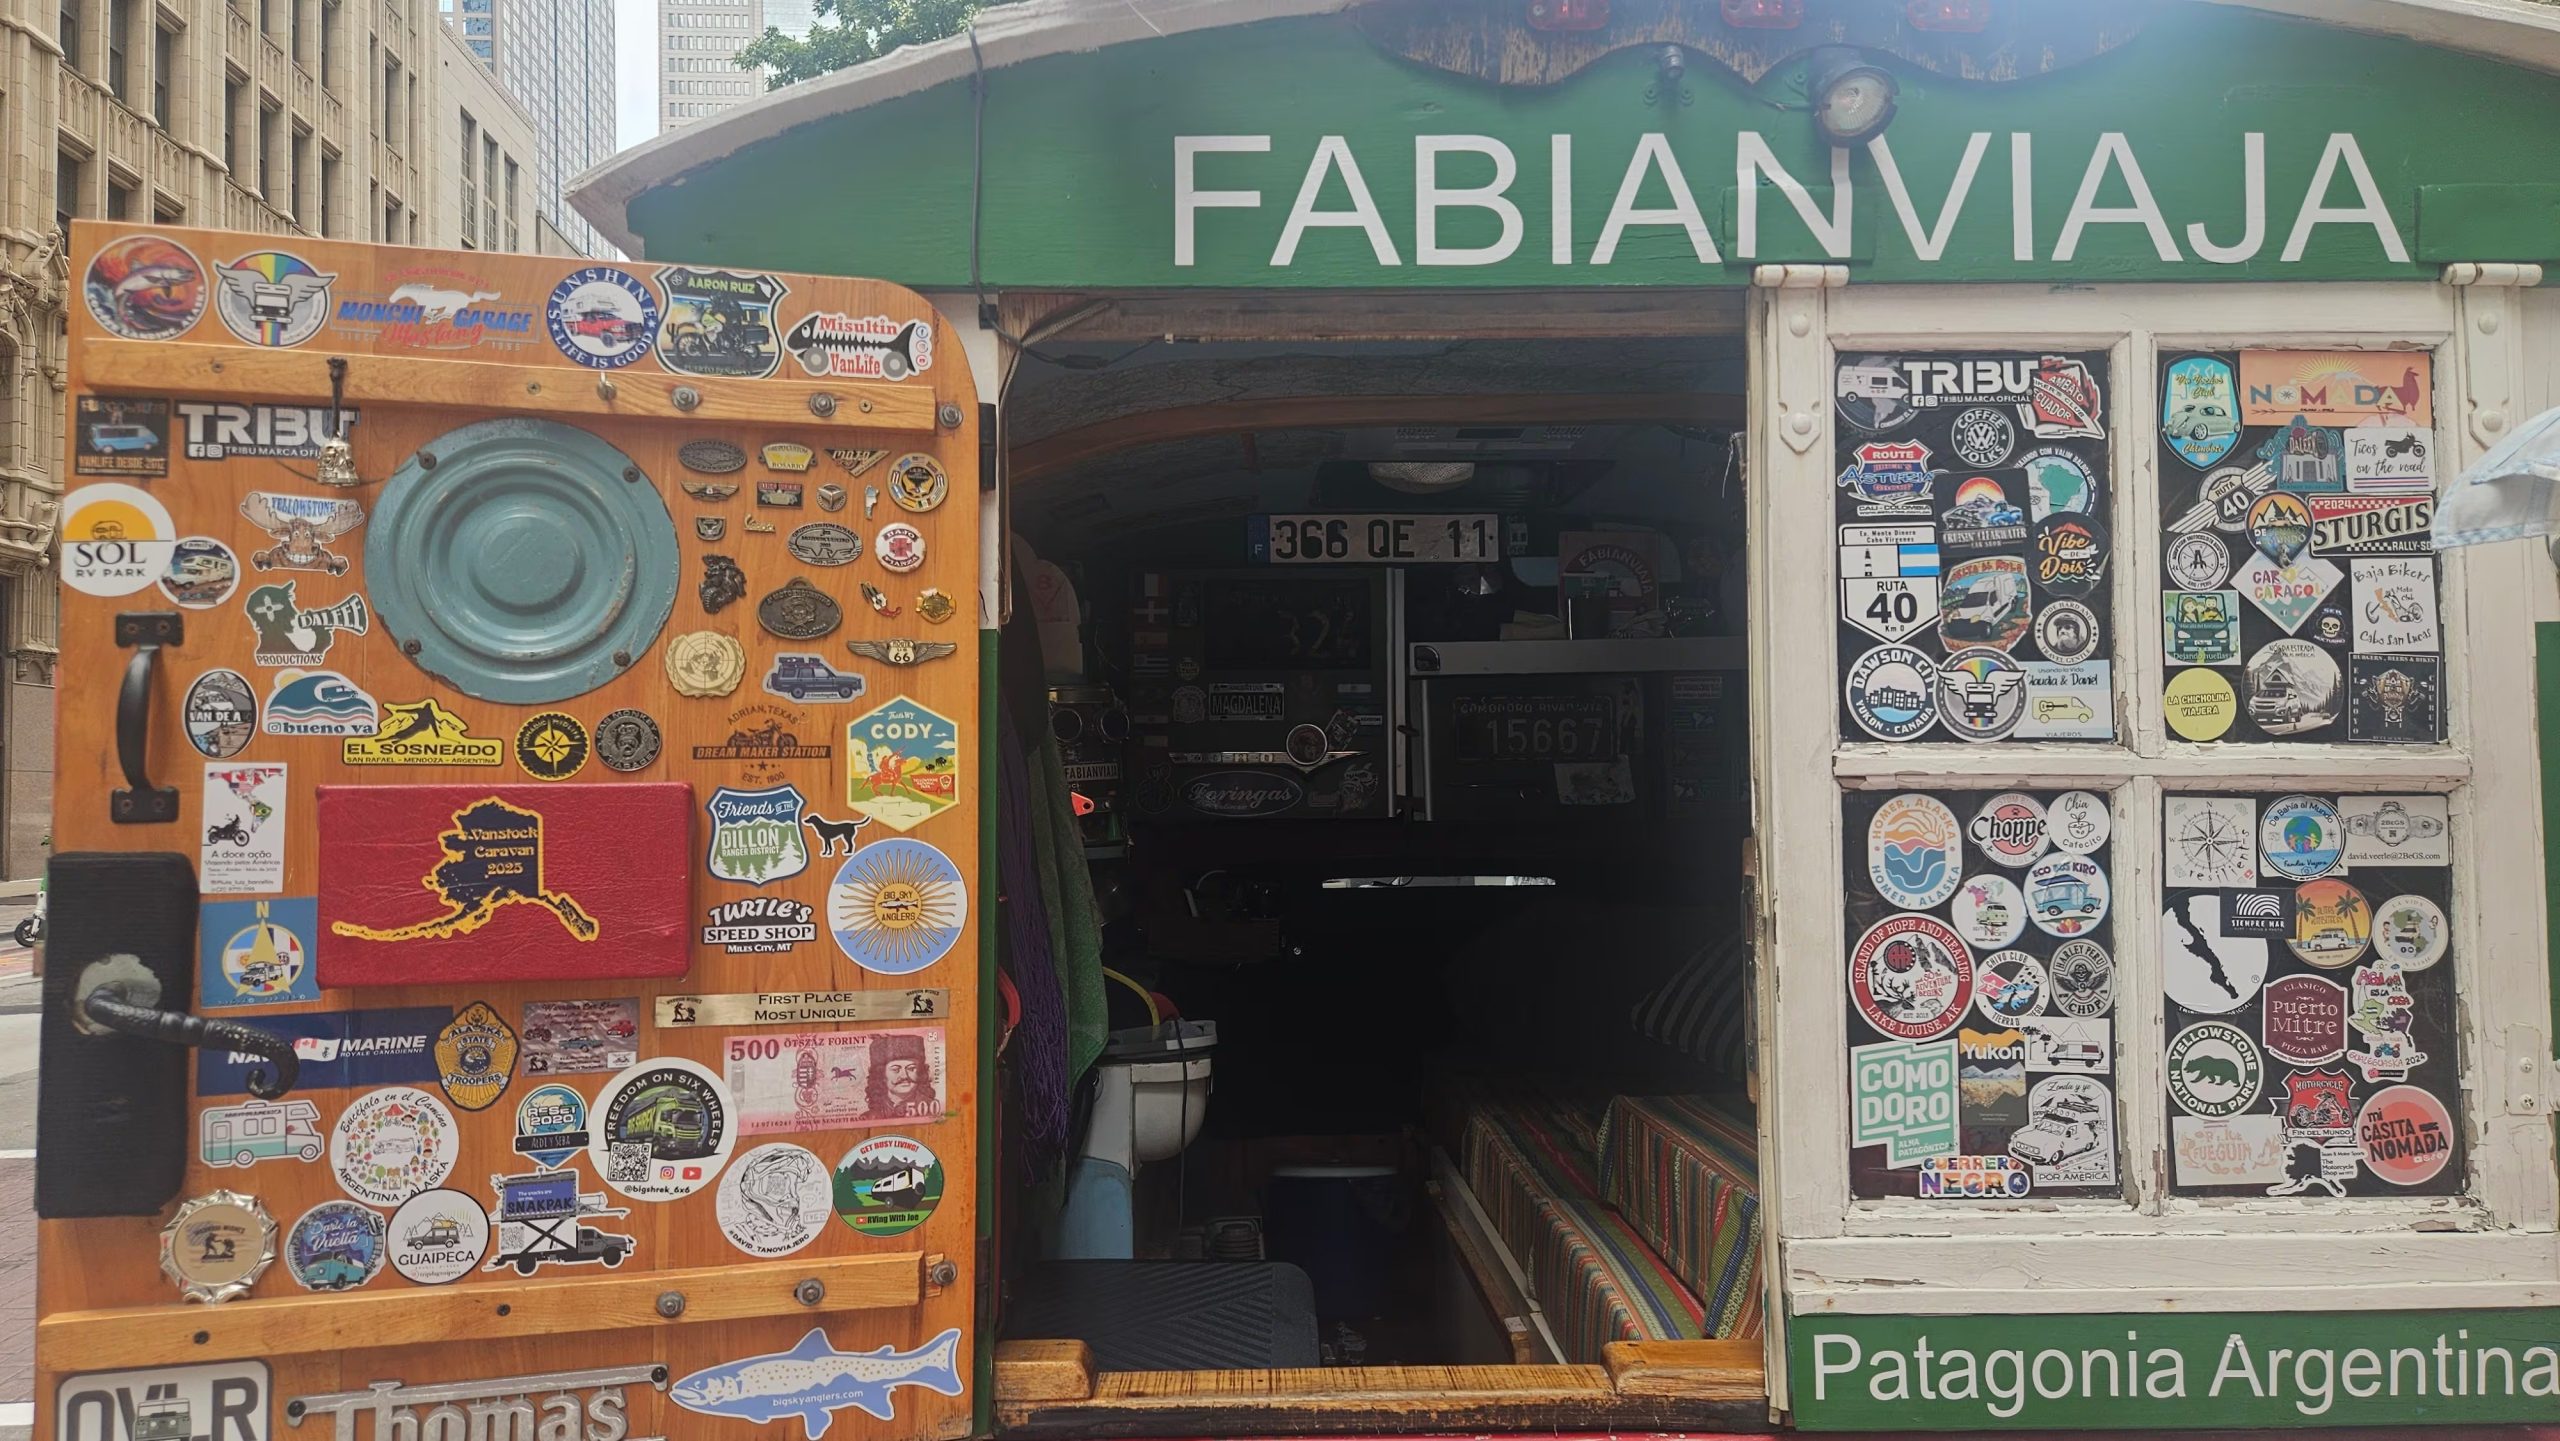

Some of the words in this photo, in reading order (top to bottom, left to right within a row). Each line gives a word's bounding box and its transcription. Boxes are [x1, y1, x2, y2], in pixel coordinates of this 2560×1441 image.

[1173, 130, 2409, 267] FABIANVIAJA
[548, 269, 653, 320] SUNSHINE
[688, 277, 729, 290] AARON
[730, 281, 755, 294] RUIZ
[337, 301, 427, 324] MONCHI
[452, 308, 533, 332] GARAGE
[819, 315, 897, 335] Misultin
[556, 334, 586, 364] LIFE
[592, 357, 608, 368] IS
[614, 333, 653, 367] GOOD
[830, 353, 880, 374] VanLife
[1903, 360, 2039, 394] TRIBU
[2048, 375, 2084, 402] AMBATO
[2250, 384, 2404, 405] NOMADA
[1939, 395, 1964, 403] TRIBU
[1965, 395, 1995, 403] MARCA
[176, 404, 357, 447] TRIBU
[1956, 410, 2006, 429] COFFEE
[225, 446, 256, 456] TRIBU
[258, 448, 298, 456] MARCA
[1872, 451, 1915, 459] ROUTE
[1960, 446, 2006, 463] VOLKS
[2351, 438, 2378, 457] Ticos
[2356, 464, 2371, 475] on
[2375, 459, 2393, 476] the
[2399, 456, 2425, 473] road
[2215, 480, 2236, 498] RUTA
[271, 497, 337, 517] YELLOWSTONE
[2223, 491, 2249, 519] 40
[2324, 500, 2352, 509] 2024
[2313, 502, 2431, 546] STURGIS
[1275, 519, 1348, 559] 366
[1367, 519, 1415, 558] QE
[1446, 519, 1486, 558] 11
[2039, 533, 2090, 555] Vibe
[73, 541, 147, 568] SOL
[76, 569, 97, 578] RV
[104, 568, 146, 578] PARK
[2039, 559, 2087, 581] Dois
[2253, 570, 2280, 583] CAR
[1877, 581, 1908, 592] RUTA
[2254, 583, 2325, 600] CARACOL
[1866, 593, 1918, 624] 40
[257, 654, 323, 665] PRODUCTIONS
[894, 652, 911, 662] 66
[1852, 648, 1914, 689] DAWSON
[1211, 698, 1282, 716] MAGDALENA
[2167, 696, 2180, 705] LA
[2181, 692, 2231, 704] CHICHOLINA
[190, 711, 214, 722] VAN
[216, 712, 229, 722] DE
[727, 707, 767, 726] ADRIAN,
[767, 704, 799, 725] TEXAS
[1855, 699, 1884, 732] YUKON
[1893, 707, 1934, 734] CANADA
[2181, 706, 2219, 717] VIAJERA
[284, 722, 346, 734] bueno
[352, 724, 373, 734] va
[871, 723, 933, 739] CODY
[1486, 719, 1603, 754] 15667
[347, 744, 373, 756] EL
[380, 744, 496, 756] SOSNEADO
[697, 746, 736, 758] DREAM
[740, 746, 780, 758] MAKER
[783, 746, 828, 758] STATION
[1064, 764, 1118, 780] FABIANVIAJA
[718, 801, 775, 818] Friends
[775, 804, 784, 813] OF
[783, 800, 795, 812] THE
[1872, 799, 1911, 839] HOMER,
[1915, 798, 1957, 840] ALASKA
[471, 827, 538, 841] Vanstock
[721, 828, 779, 848] DILLON
[1971, 816, 2048, 844] Choppe
[474, 845, 534, 858] Caravan
[722, 848, 748, 857] RANGER
[750, 846, 779, 855] DISTRICT
[487, 862, 524, 876] 2025
[884, 891, 896, 899] BIG
[899, 891, 913, 899] SKY
[1871, 865, 1912, 907] HOMER,
[1919, 865, 1961, 906] ALASKA
[881, 912, 915, 921] ANGLERS
[2232, 919, 2266, 928] SIEMPRE
[2269, 920, 2285, 928] MAR
[707, 929, 759, 941] SPEED
[765, 927, 811, 939] SHOP
[1856, 943, 1874, 983] ISLAND
[1872, 929, 1885, 943] OF
[1888, 920, 1915, 934] HOPE
[1919, 922, 1942, 938] AND
[1942, 934, 1970, 982] HEALING
[2067, 998, 2103, 1015] CHDP
[2272, 1000, 2338, 1016] Puerto
[1867, 1005, 1895, 1030] LAKE
[1900, 1020, 1946, 1035] LOUISE,
[1948, 1004, 1961, 1020] AK
[2272, 1016, 2338, 1035] Mitre
[342, 1035, 427, 1052] MARINE
[730, 1038, 780, 1062] 500
[828, 1036, 866, 1046] FORINT
[2171, 1028, 2257, 1072] YELLOWSTONE
[373, 1048, 424, 1056] CANADIENNE
[1962, 1042, 2025, 1061] Yukon
[449, 1074, 500, 1084] TROOPERS
[1860, 1059, 1949, 1092] COMO
[2170, 1070, 2226, 1114] NATIONAL
[2229, 1080, 2257, 1112] PARK
[2295, 1080, 2344, 1092] MOTORCYCLE
[527, 1104, 580, 1117] RESET
[607, 1078, 648, 1140] FREEDOM
[651, 1073, 673, 1083] ON
[679, 1075, 701, 1091] SIX
[702, 1089, 718, 1147] WHEELS
[905, 1100, 941, 1117] 500
[1861, 1092, 1949, 1126] DORO
[2367, 1108, 2383, 1122] mi
[530, 1115, 575, 1126] 2020
[2361, 1118, 2415, 1142] CASITA
[860, 1143, 873, 1154] GET
[874, 1140, 892, 1151] BUSY
[893, 1140, 920, 1152] LIVING!
[2368, 1132, 2449, 1162] NOMADA
[1923, 1157, 2024, 1170] GUERRERO
[338, 1167, 399, 1202] ARGENTINA
[1921, 1172, 2028, 1195] NEGRO
[2038, 1173, 2061, 1181] POR
[2063, 1172, 2109, 1181] AMERICA
[624, 1184, 691, 1195] @bigshrek_6x6
[507, 1199, 574, 1214] SNAKPAK
[867, 1214, 888, 1224] RVing
[889, 1214, 905, 1223] With
[906, 1214, 919, 1222] Joe
[399, 1251, 476, 1266] GUAIPECA
[1813, 1330, 2186, 1417] Patagonia
[2208, 1328, 2560, 1416] Argentina
[772, 1389, 864, 1407] bigskyanglers.com
[66, 1376, 259, 1441] OVR
